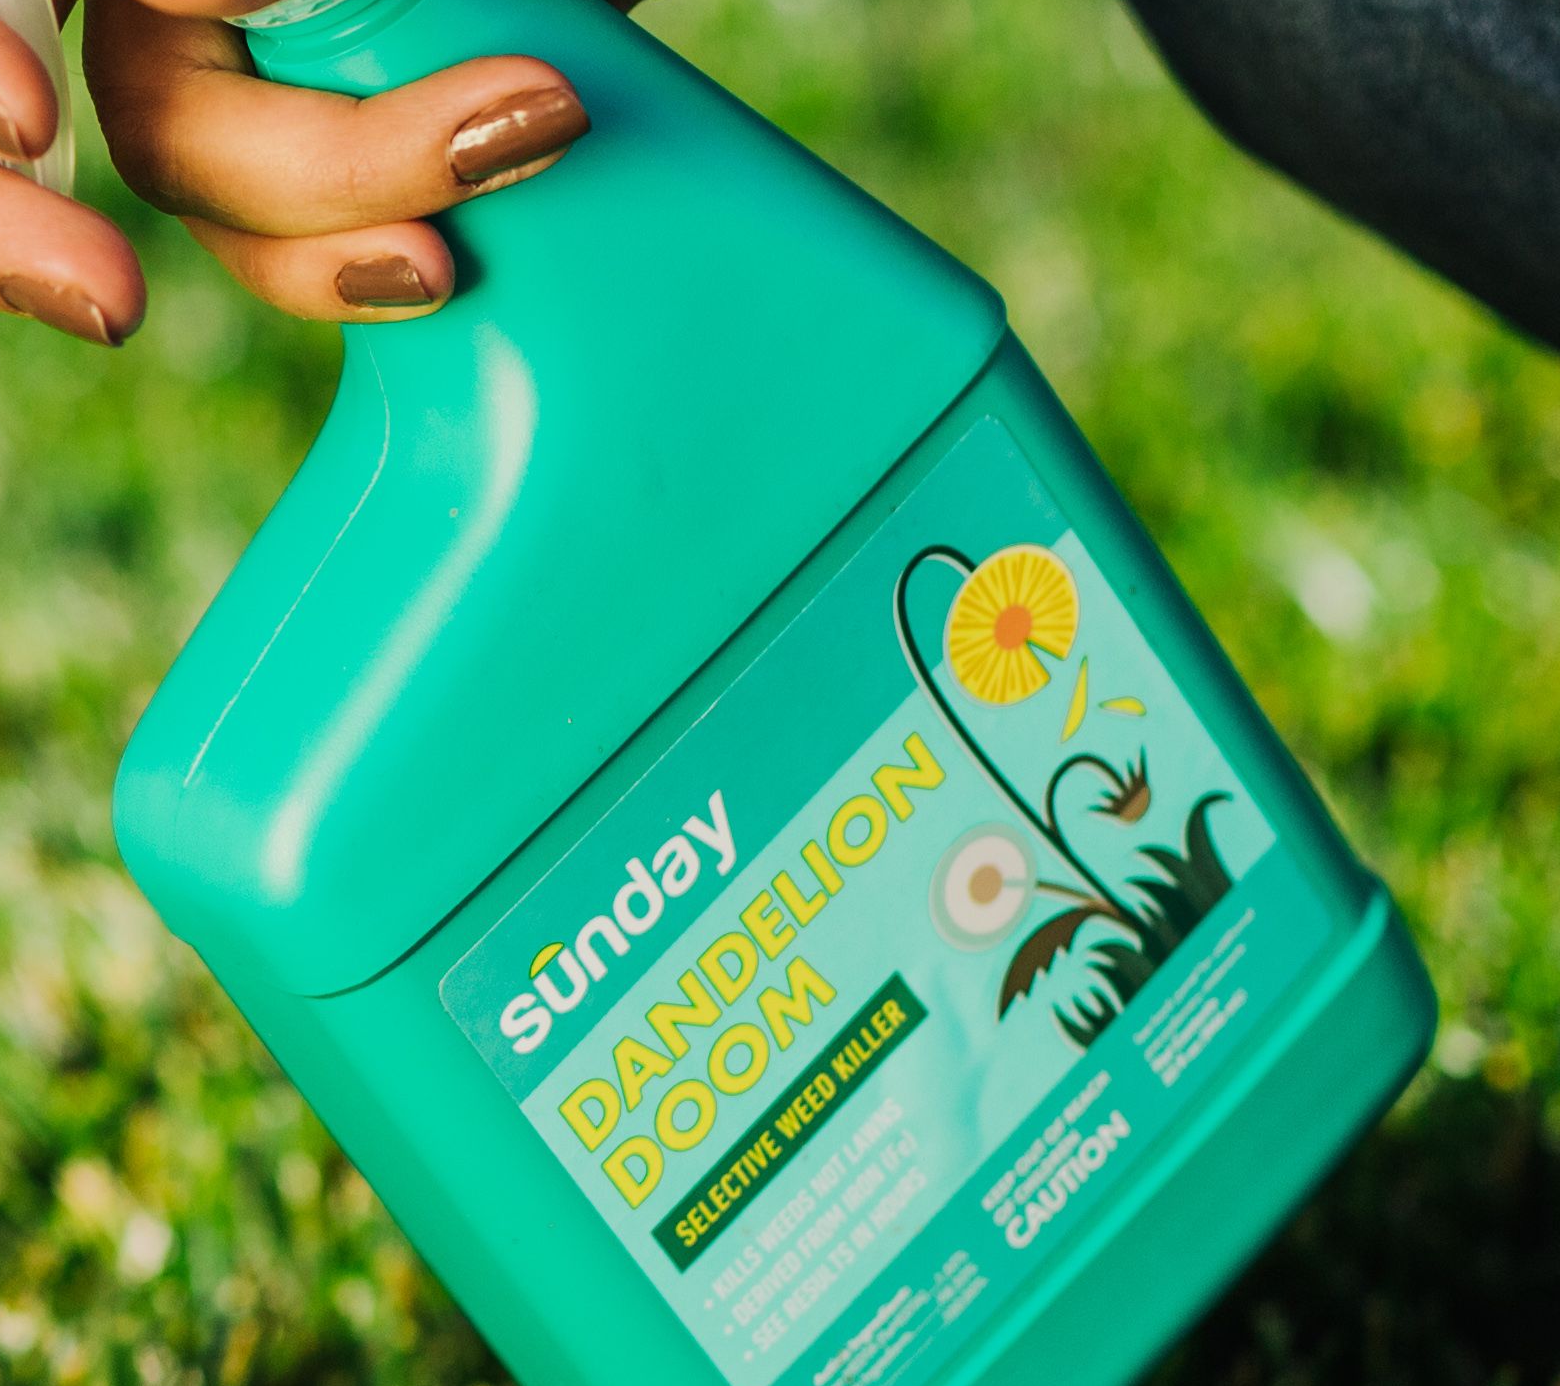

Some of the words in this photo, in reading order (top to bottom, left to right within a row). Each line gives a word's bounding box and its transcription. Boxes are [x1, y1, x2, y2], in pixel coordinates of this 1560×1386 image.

[498, 788, 737, 1055] sunday
[557, 730, 947, 1153] DANDELION
[599, 954, 838, 1210] DOOM
[674, 1129, 782, 1247] SELECTIVE
[774, 1071, 837, 1139] WEED
[830, 998, 907, 1082] KILLER
[1004, 1109, 1131, 1249] CAUTION
[710, 1244, 763, 1301] KILLS
[755, 1188, 816, 1253] WEEDS
[808, 1152, 847, 1198] NOT
[842, 1095, 906, 1164] LAWNS
[730, 1249, 802, 1327] DERIVED
[795, 1203, 846, 1259] FROM
[840, 1163, 885, 1212] IRON
[750, 1311, 788, 1353] SEE
[781, 1240, 856, 1321] RESULTS
[849, 1221, 876, 1250] IN
[868, 1165, 928, 1232] HOURS
